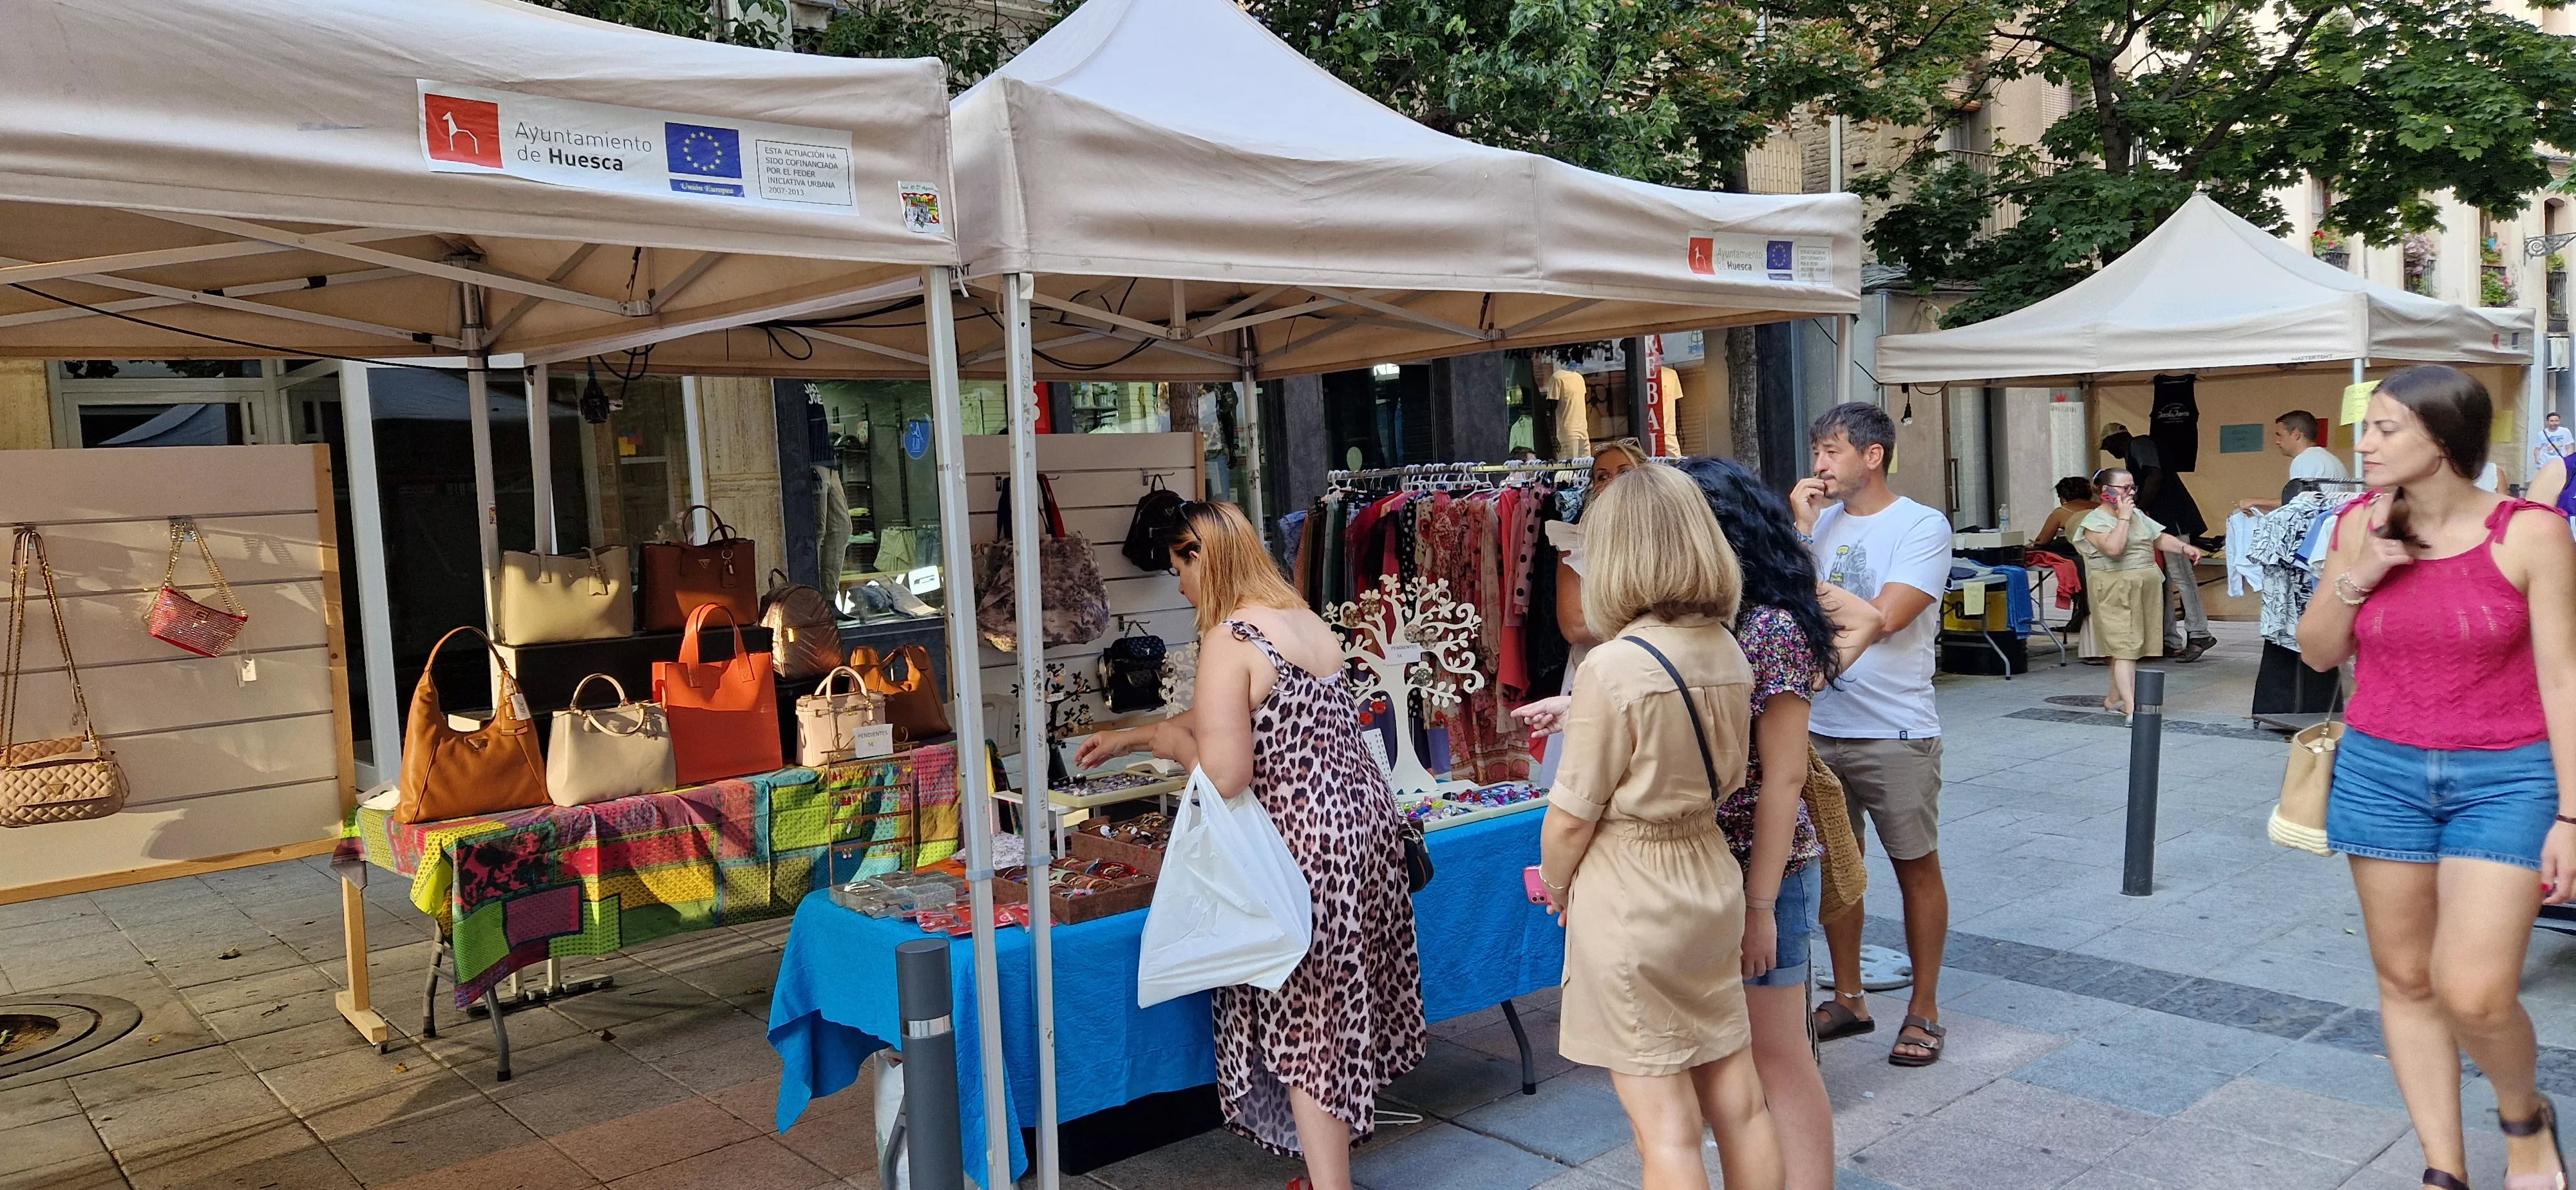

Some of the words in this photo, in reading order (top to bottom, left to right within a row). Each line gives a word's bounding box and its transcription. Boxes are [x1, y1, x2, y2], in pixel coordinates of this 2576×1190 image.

[515, 121, 652, 153] Ayuntamiento
[517, 144, 540, 162] de
[548, 147, 623, 171] Huesca
[764, 147, 782, 155] ESTA
[784, 149, 825, 160] ACTUACIÓN
[765, 157, 783, 165] SIDO
[786, 158, 838, 170] COFINANCIADA
[766, 167, 781, 175] POR
[793, 169, 816, 178] FEDER
[680, 182, 703, 192] Unión
[705, 185, 734, 194] Europea
[767, 177, 806, 187] INICIATIVA
[807, 180, 836, 189] URBANA
[768, 187, 804, 196] 2007-2013
[1717, 247, 1763, 260] Ayuntamiento
[1727, 260, 1752, 271] Huesca
